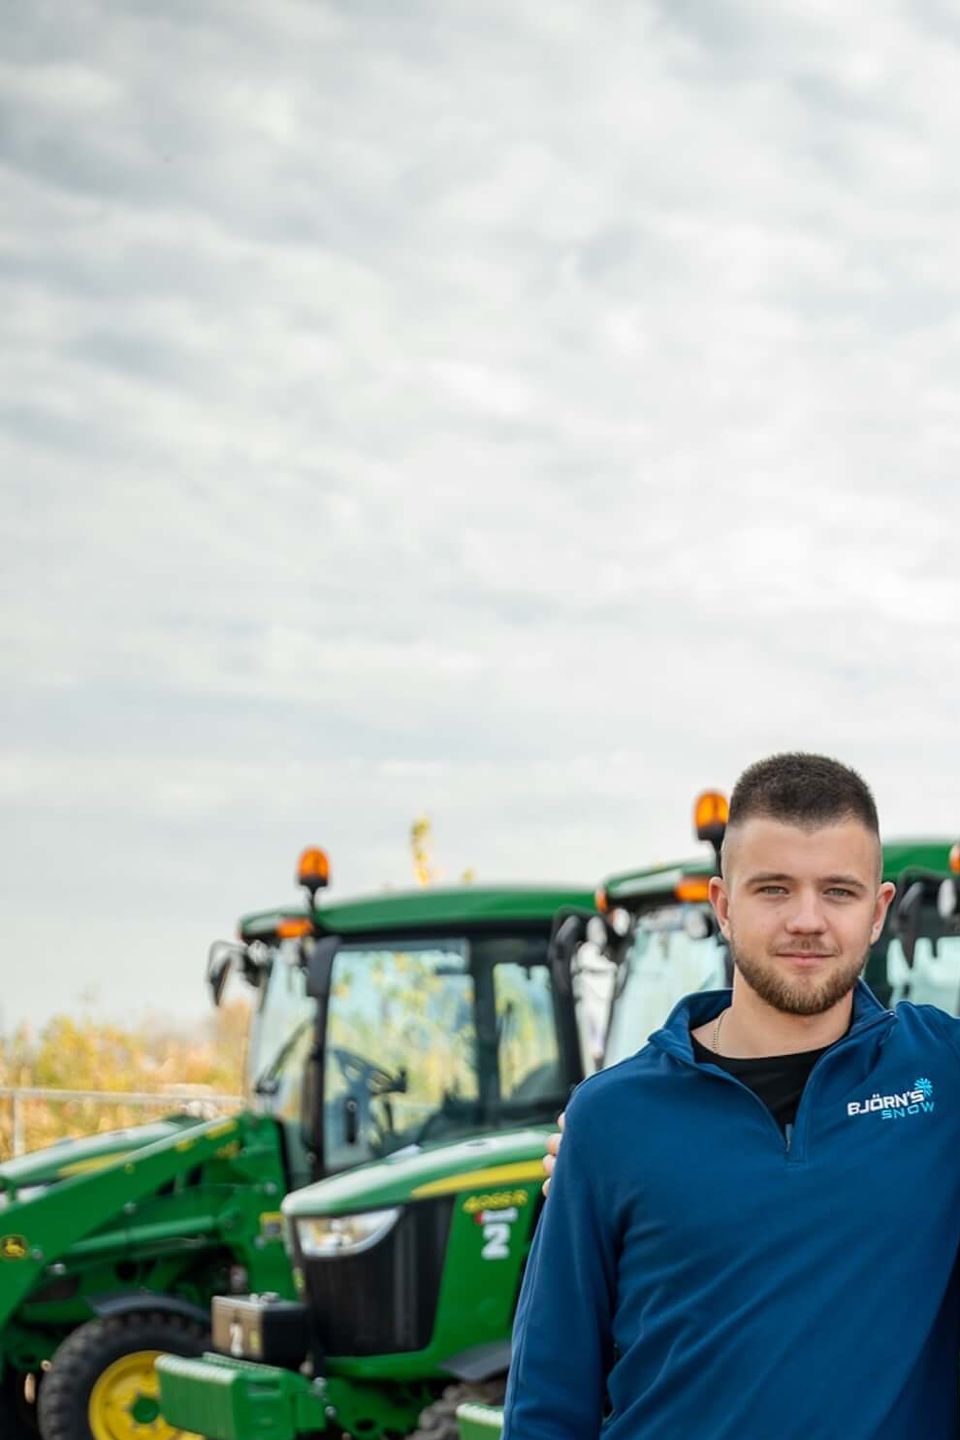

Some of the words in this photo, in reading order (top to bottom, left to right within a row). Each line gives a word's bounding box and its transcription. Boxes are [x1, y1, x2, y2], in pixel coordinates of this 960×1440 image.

[847, 1090, 925, 1116] BJÖRN'S
[881, 1101, 934, 1120] SNOW
[481, 1222, 511, 1260] 2
